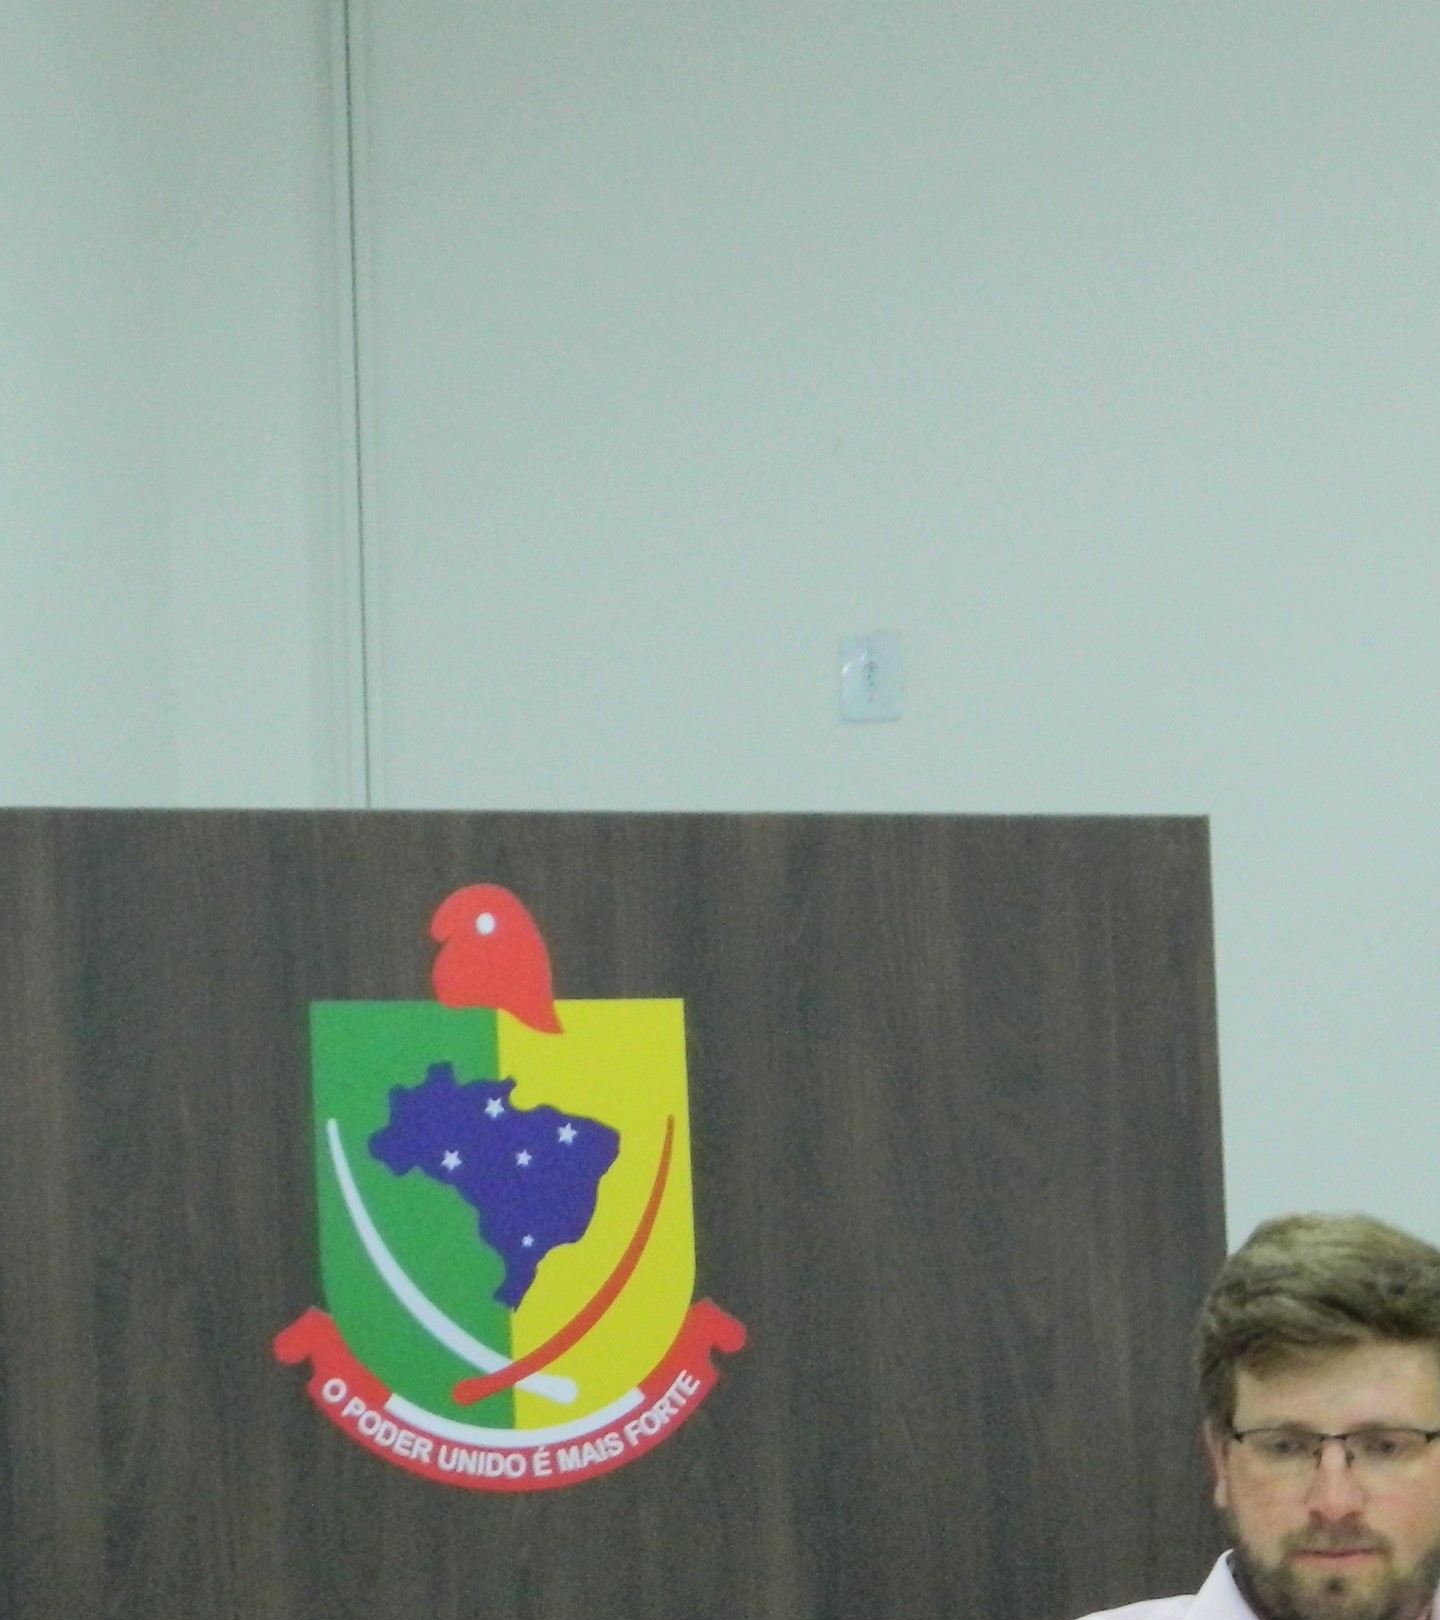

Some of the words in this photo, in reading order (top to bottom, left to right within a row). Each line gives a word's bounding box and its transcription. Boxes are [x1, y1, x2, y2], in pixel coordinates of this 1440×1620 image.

[322, 1377, 347, 1404] O
[341, 1396, 433, 1463] PODER
[437, 1445, 527, 1479] UNIDO
[533, 1446, 552, 1477] É
[556, 1431, 625, 1474] MAIS
[624, 1369, 701, 1447] FORTE
